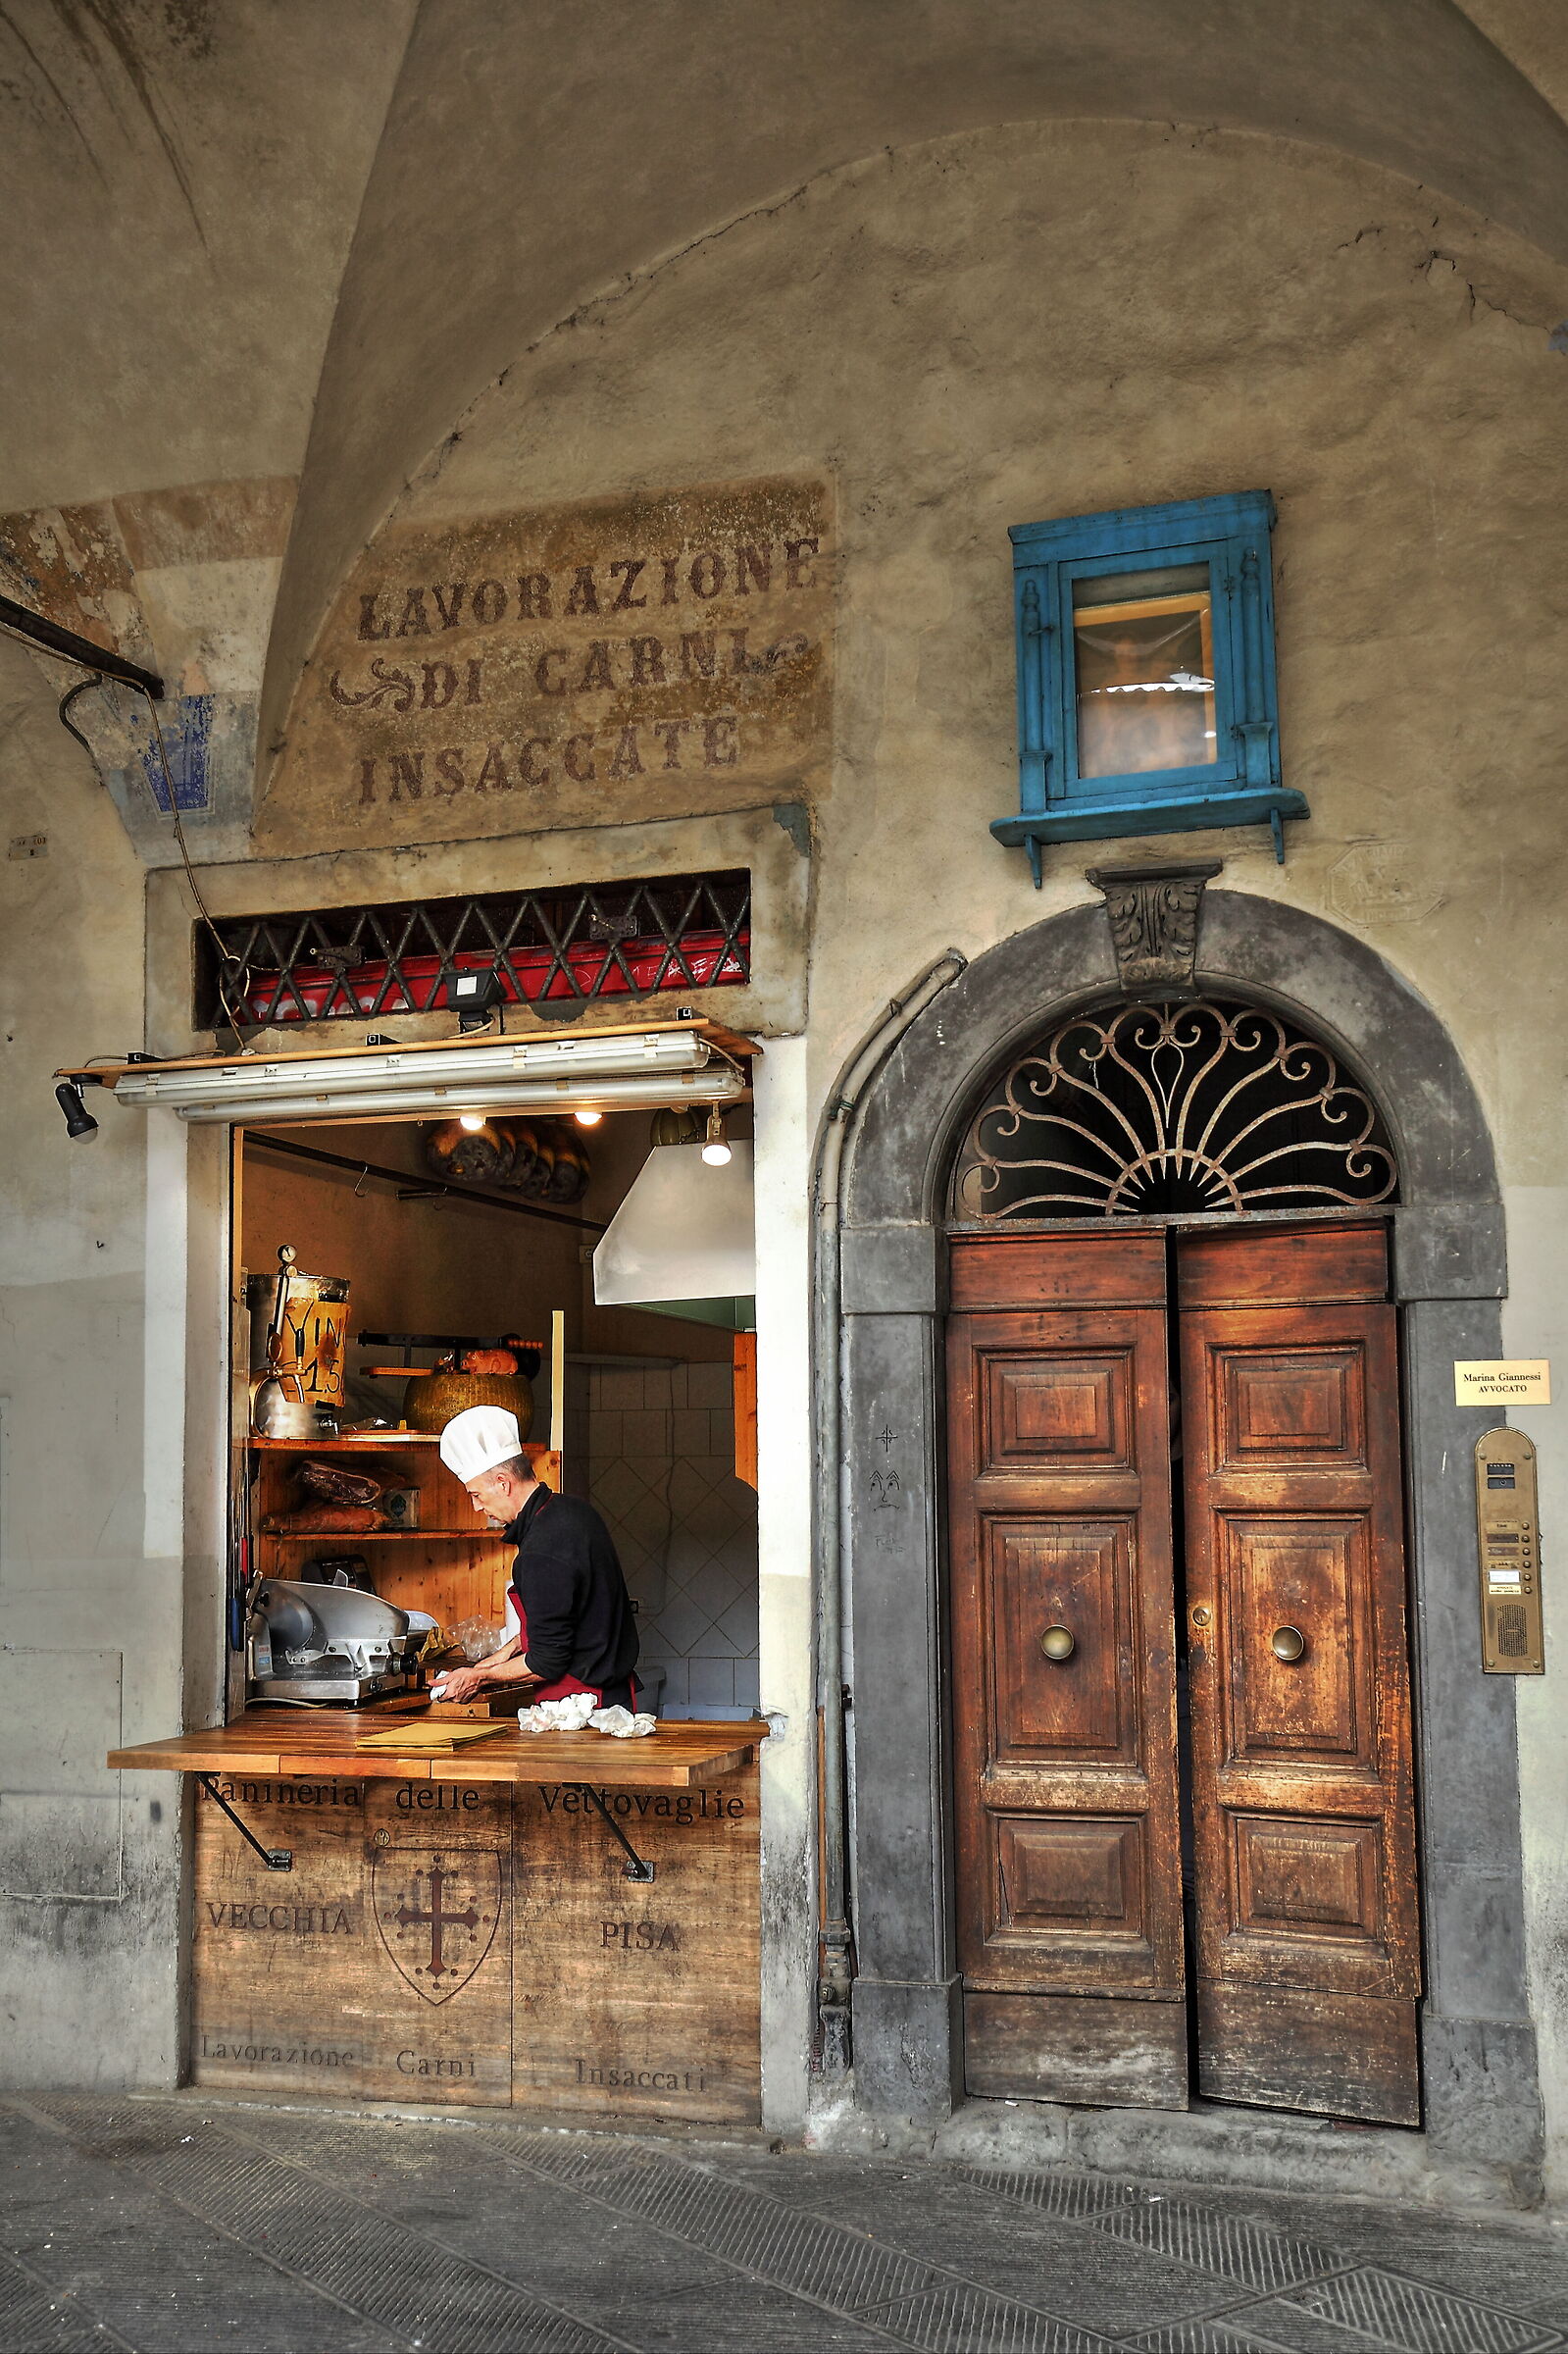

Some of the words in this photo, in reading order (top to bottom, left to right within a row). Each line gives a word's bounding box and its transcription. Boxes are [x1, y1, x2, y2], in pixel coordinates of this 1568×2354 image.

[357, 537, 820, 640] LAVORAZIONE
[420, 656, 483, 710] DI
[534, 626, 752, 698] CARNI
[358, 715, 740, 805] INSACCATE
[285, 1301, 345, 1349] VIN
[1463, 1373, 1495, 1383] Marina
[1498, 1371, 1542, 1382] Giannessi
[1478, 1384, 1528, 1393] AVVOCATO
[202, 1776, 362, 1806] Panineria
[395, 1780, 480, 1811] delle
[537, 1785, 745, 1825] Vettovaglie
[205, 1902, 354, 1935] VECCHIA
[599, 1920, 681, 1952] PISA
[200, 2034, 355, 2068] Lavorazione
[395, 2049, 476, 2078] Carni
[575, 2059, 707, 2093] Insaccati
